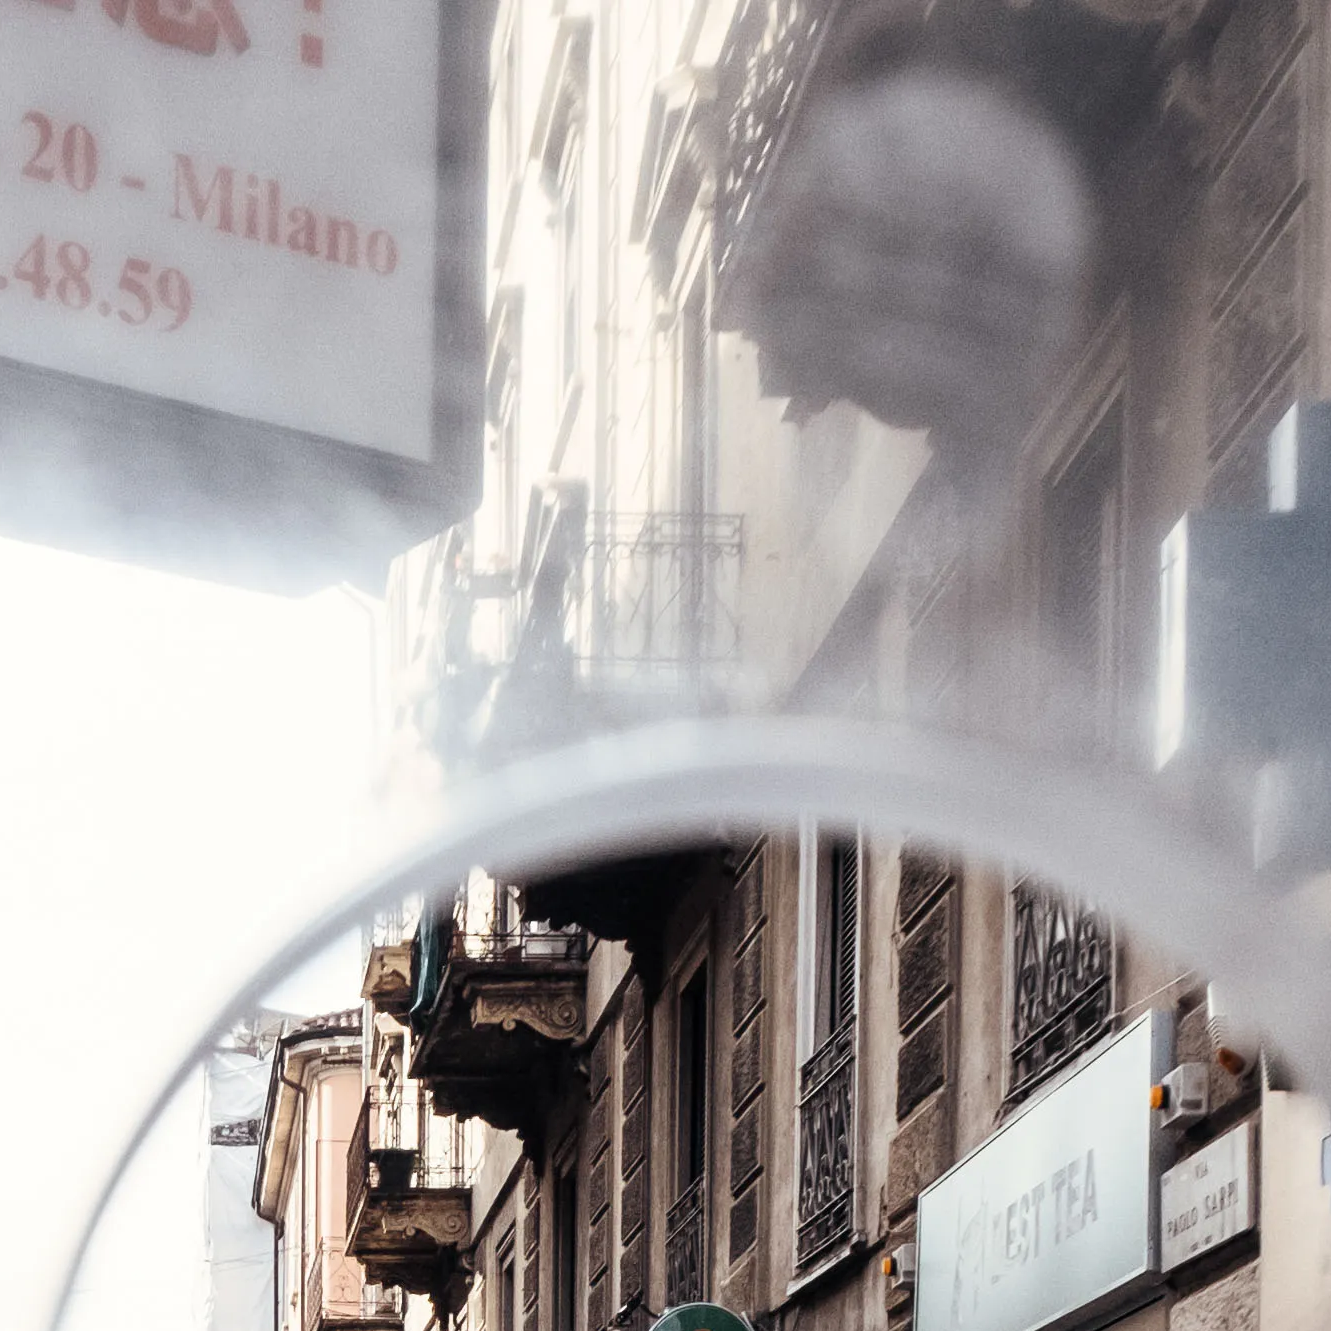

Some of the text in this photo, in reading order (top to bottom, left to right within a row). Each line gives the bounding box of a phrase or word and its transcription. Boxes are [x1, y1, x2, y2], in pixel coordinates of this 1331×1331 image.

[21, 110, 99, 194] 20
[172, 153, 401, 277] Milano
[1052, 1147, 1099, 1247] TEA
[1166, 1178, 1239, 1237] PAOLO SARPI
